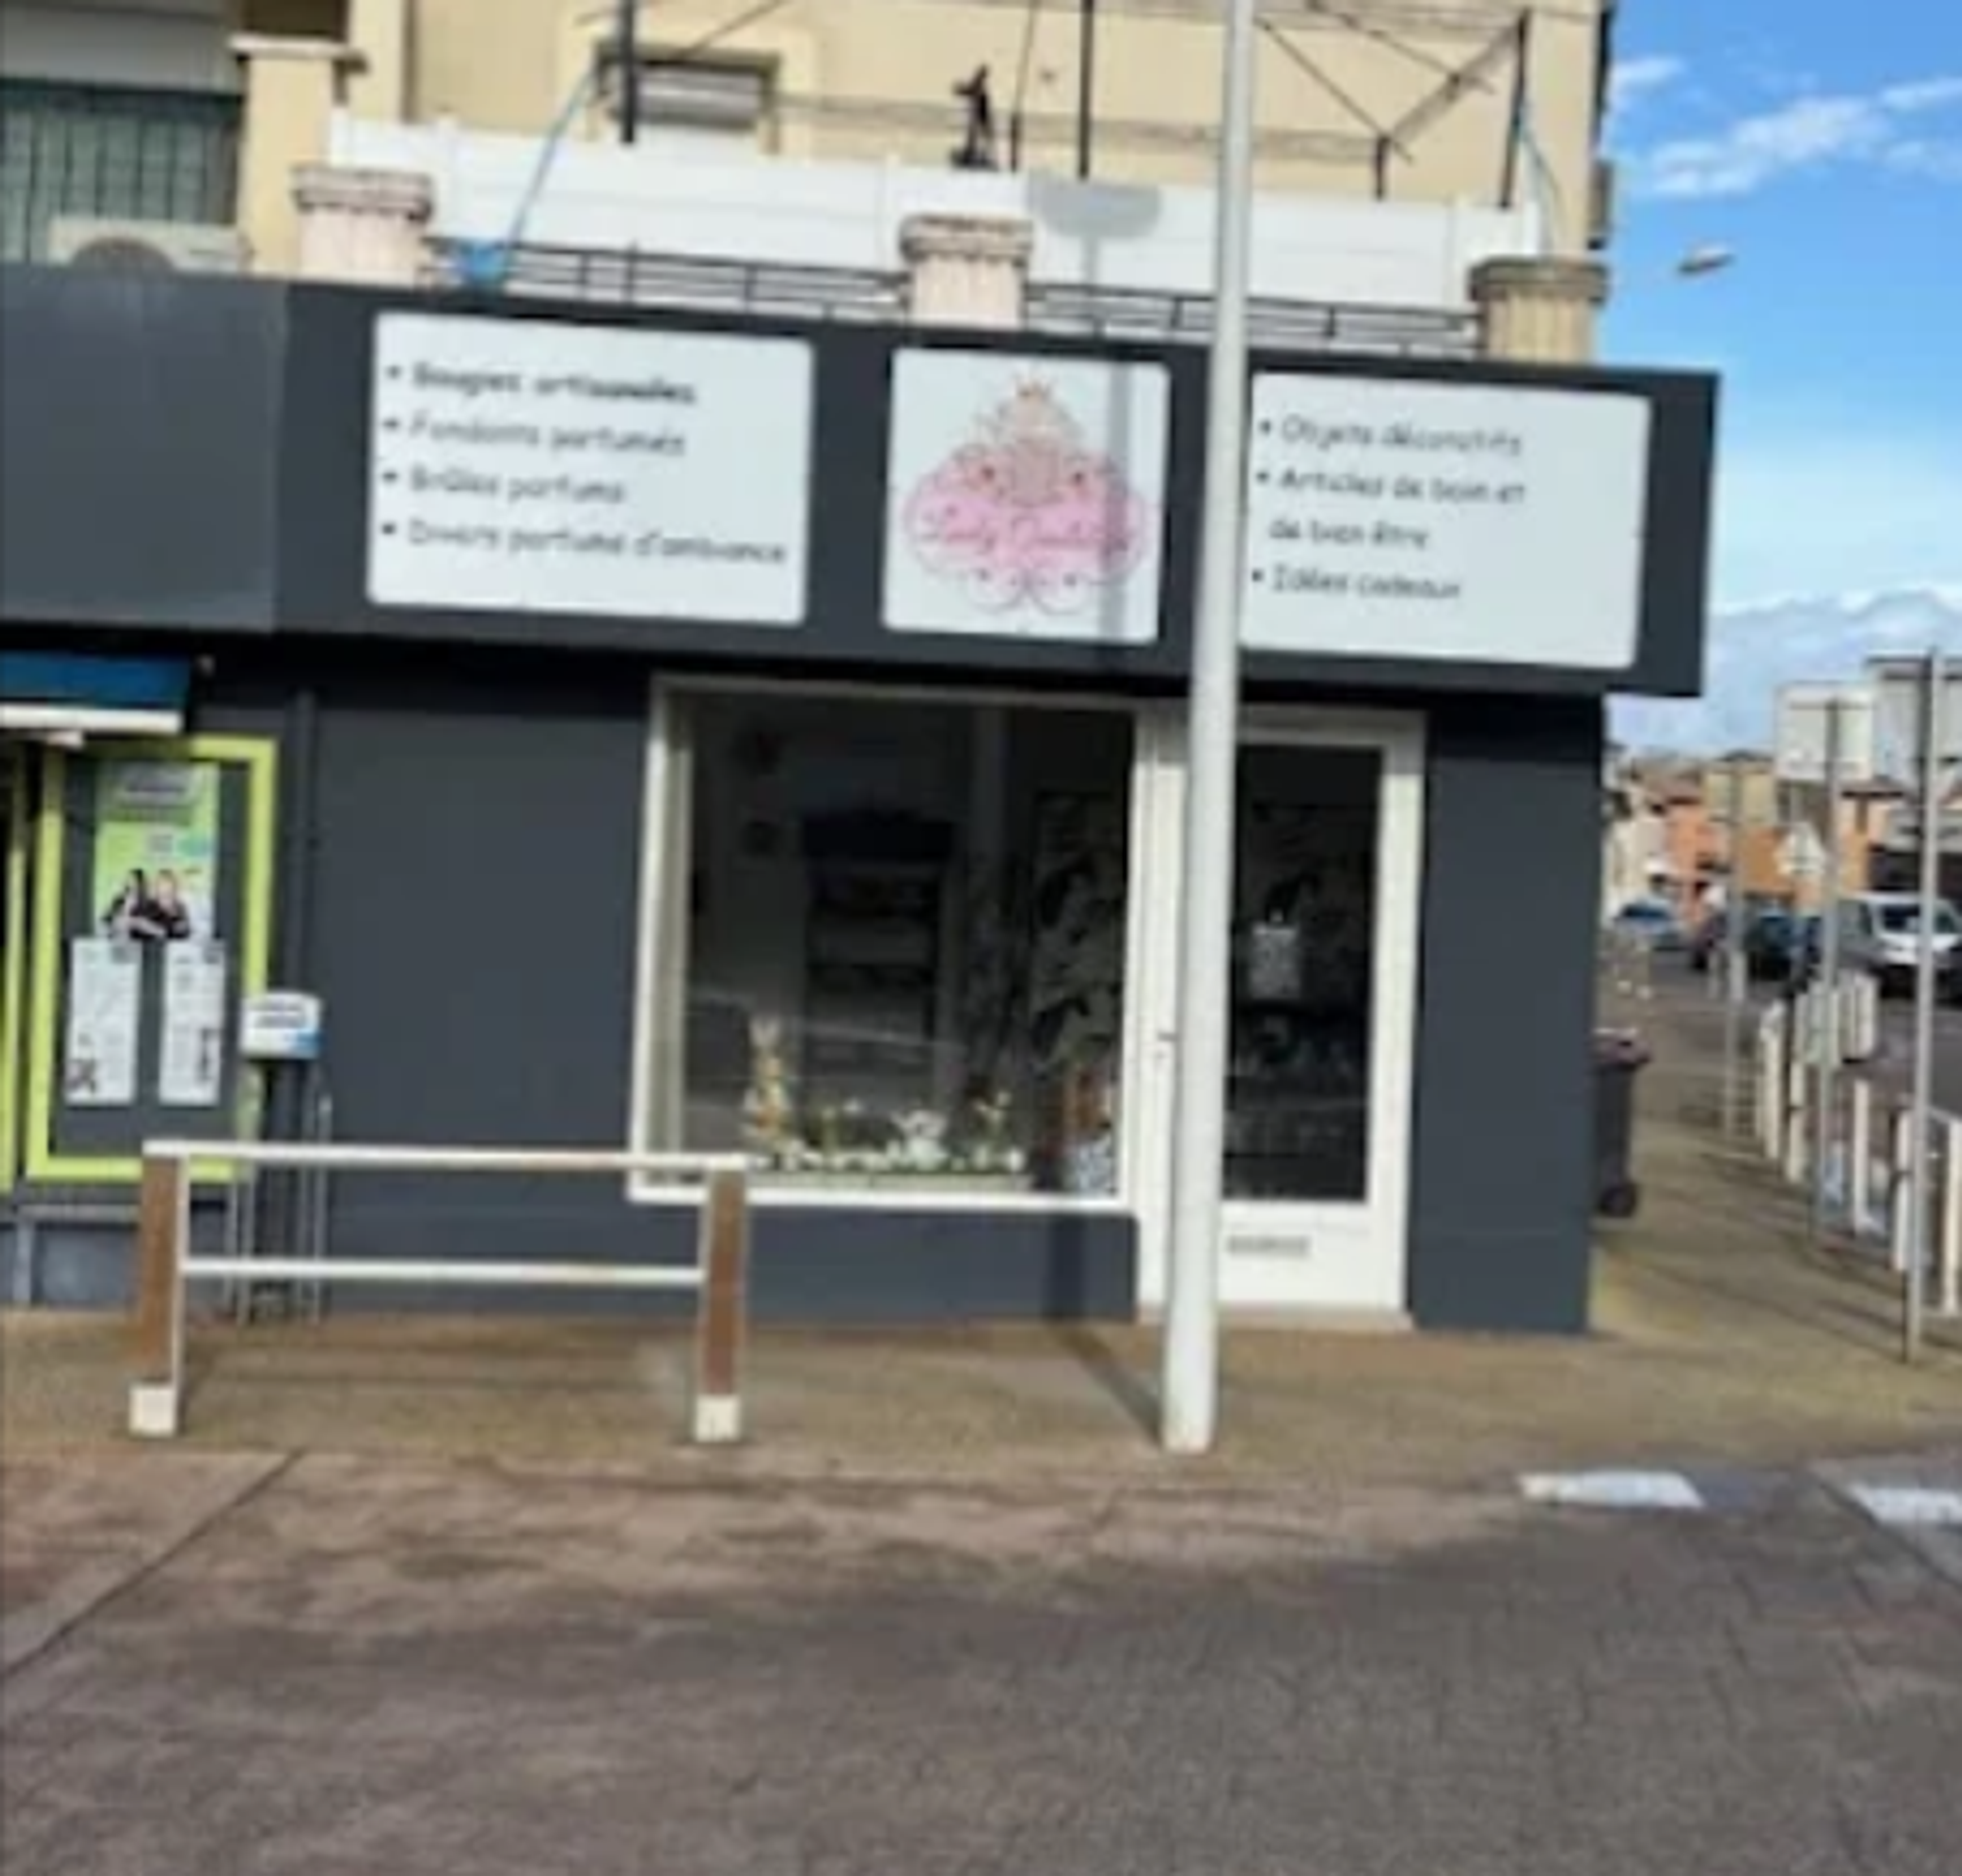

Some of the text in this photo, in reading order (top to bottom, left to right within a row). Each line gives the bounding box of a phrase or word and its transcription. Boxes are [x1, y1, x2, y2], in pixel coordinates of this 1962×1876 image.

[413, 362, 521, 397] Bougies
[1281, 414, 1372, 450] Objets
[1279, 467, 1383, 497] Articles
[1393, 473, 1421, 499] de
[1497, 483, 1525, 504] et
[1268, 519, 1300, 541] de
[1311, 521, 1364, 546] bien
[1272, 562, 1348, 593] Idées
